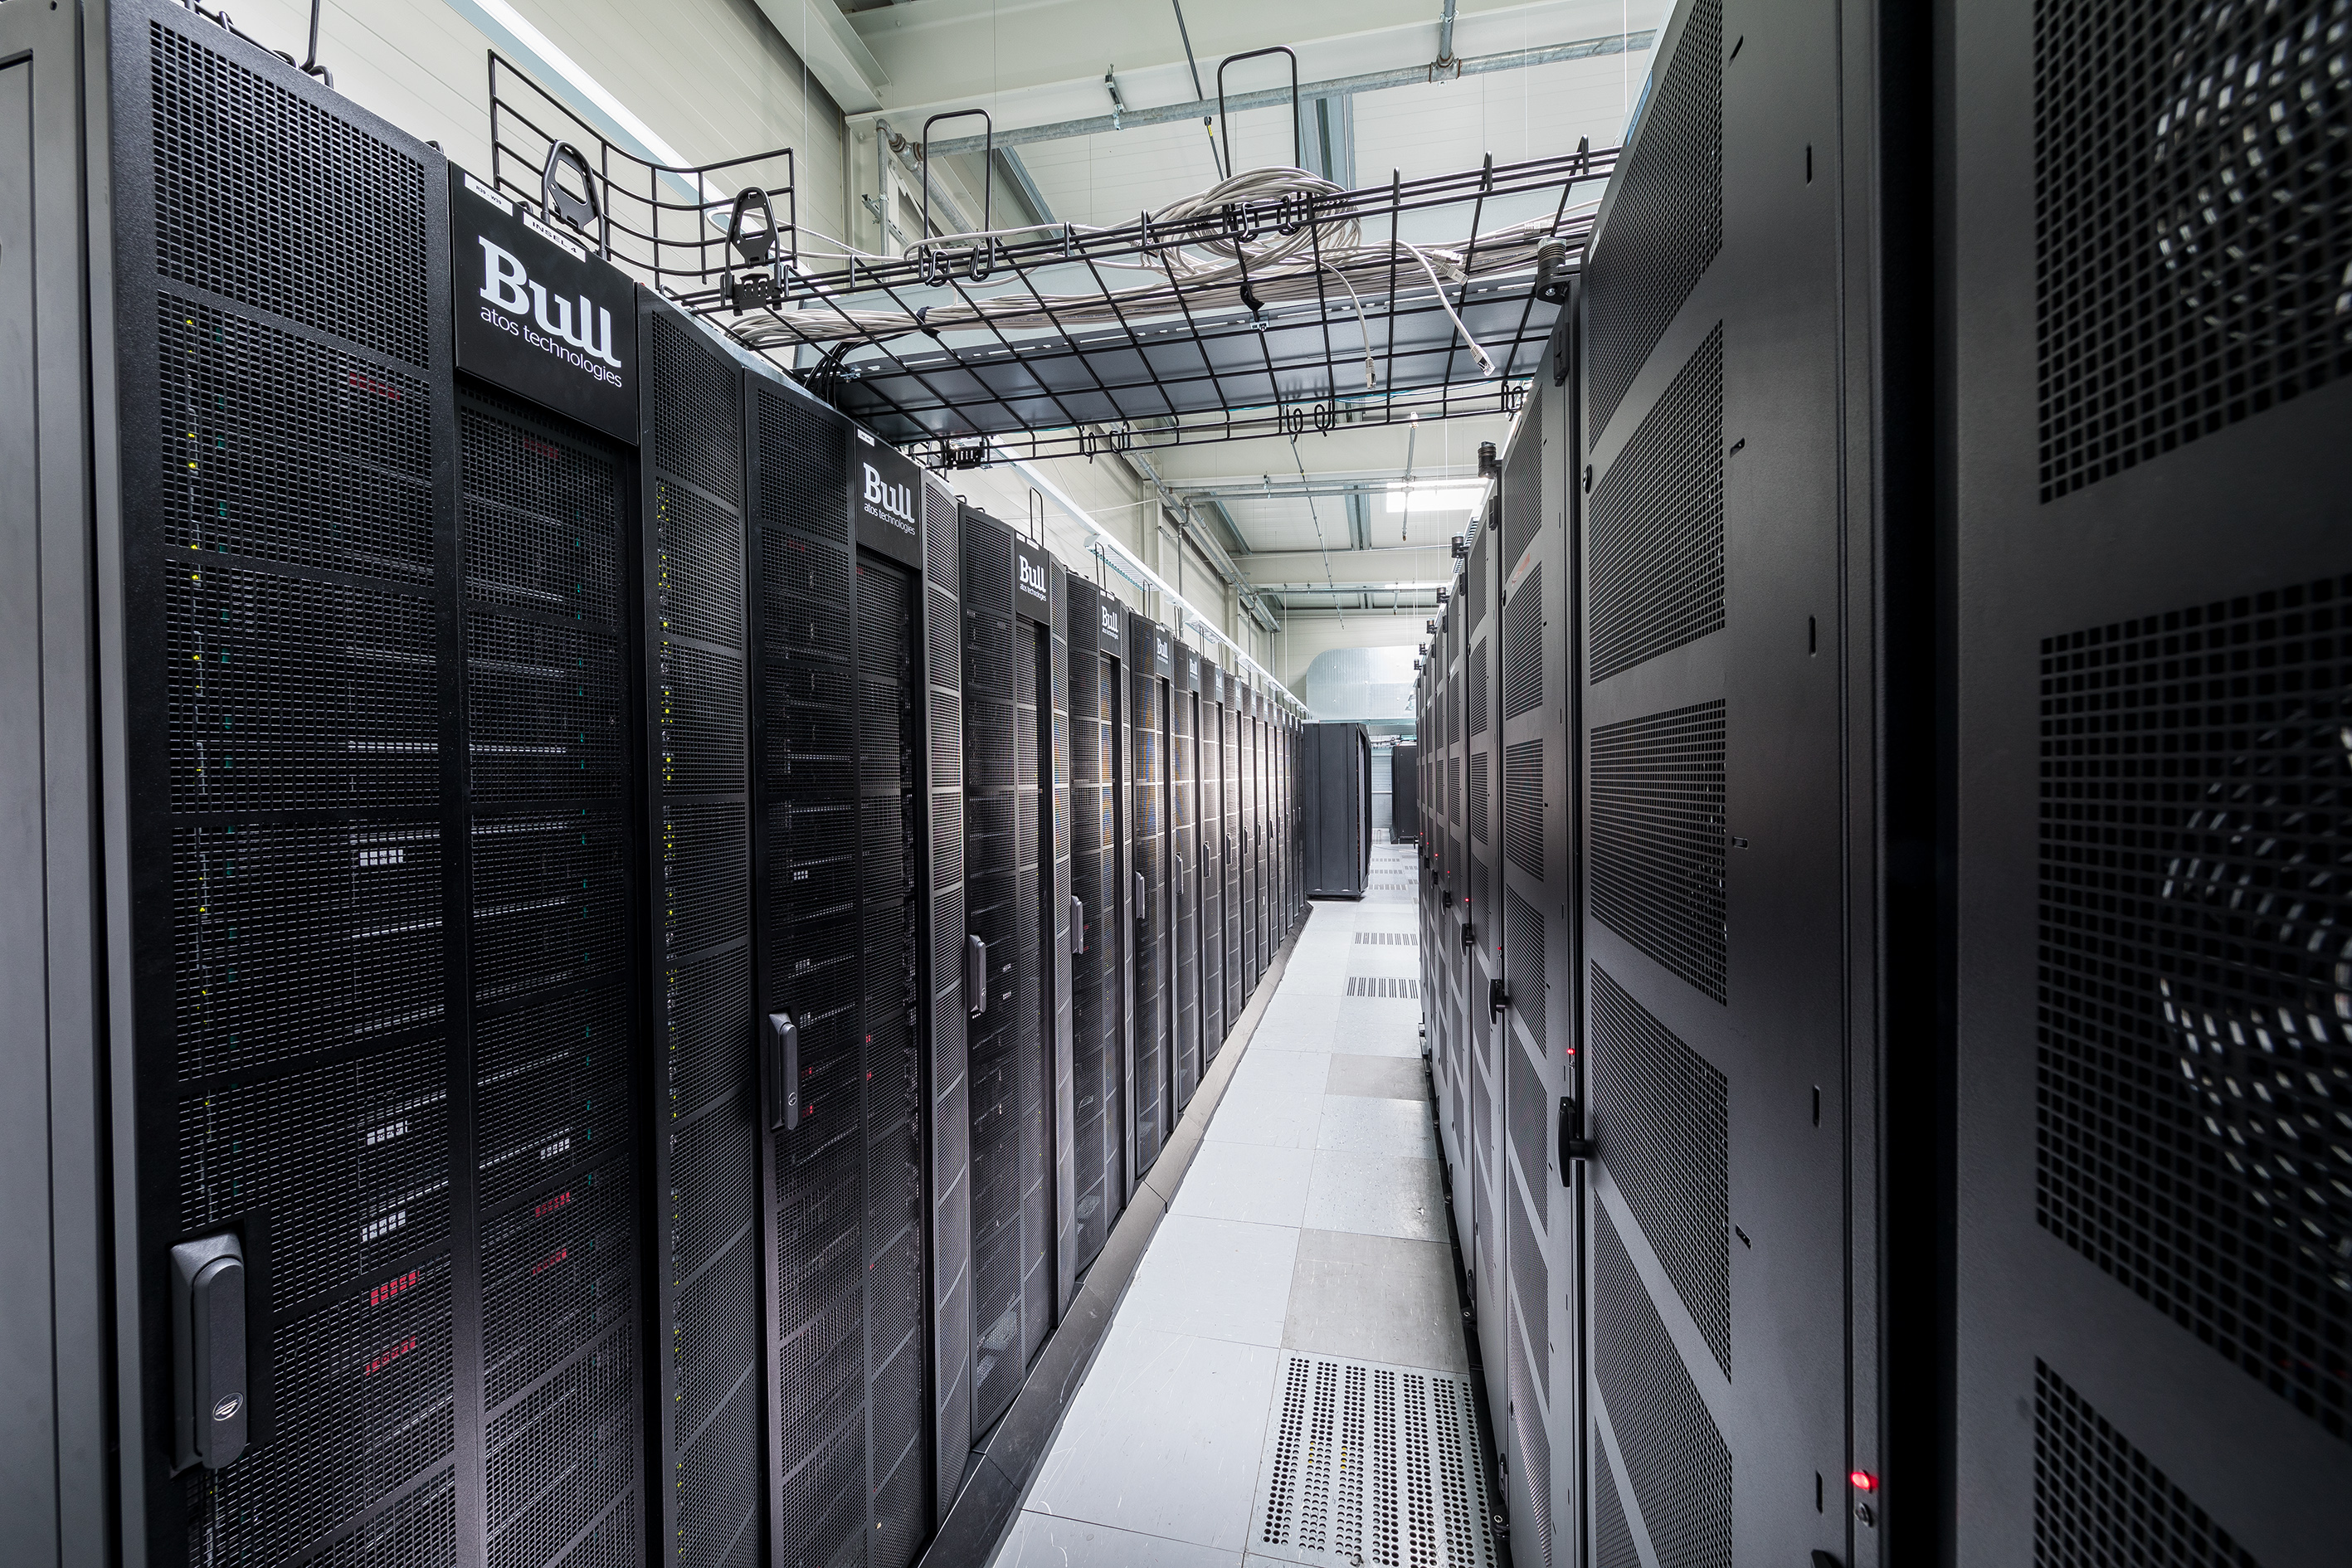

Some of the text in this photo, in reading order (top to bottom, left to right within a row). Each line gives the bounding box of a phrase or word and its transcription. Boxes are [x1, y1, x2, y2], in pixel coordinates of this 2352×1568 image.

[532, 221, 567, 248] INSEL
[478, 235, 621, 368] Bull
[480, 306, 622, 388] atos technologies
[864, 462, 915, 523] Bull
[864, 503, 916, 536] atos technologies
[1019, 554, 1046, 593] Bull
[1102, 606, 1118, 633] Bull
